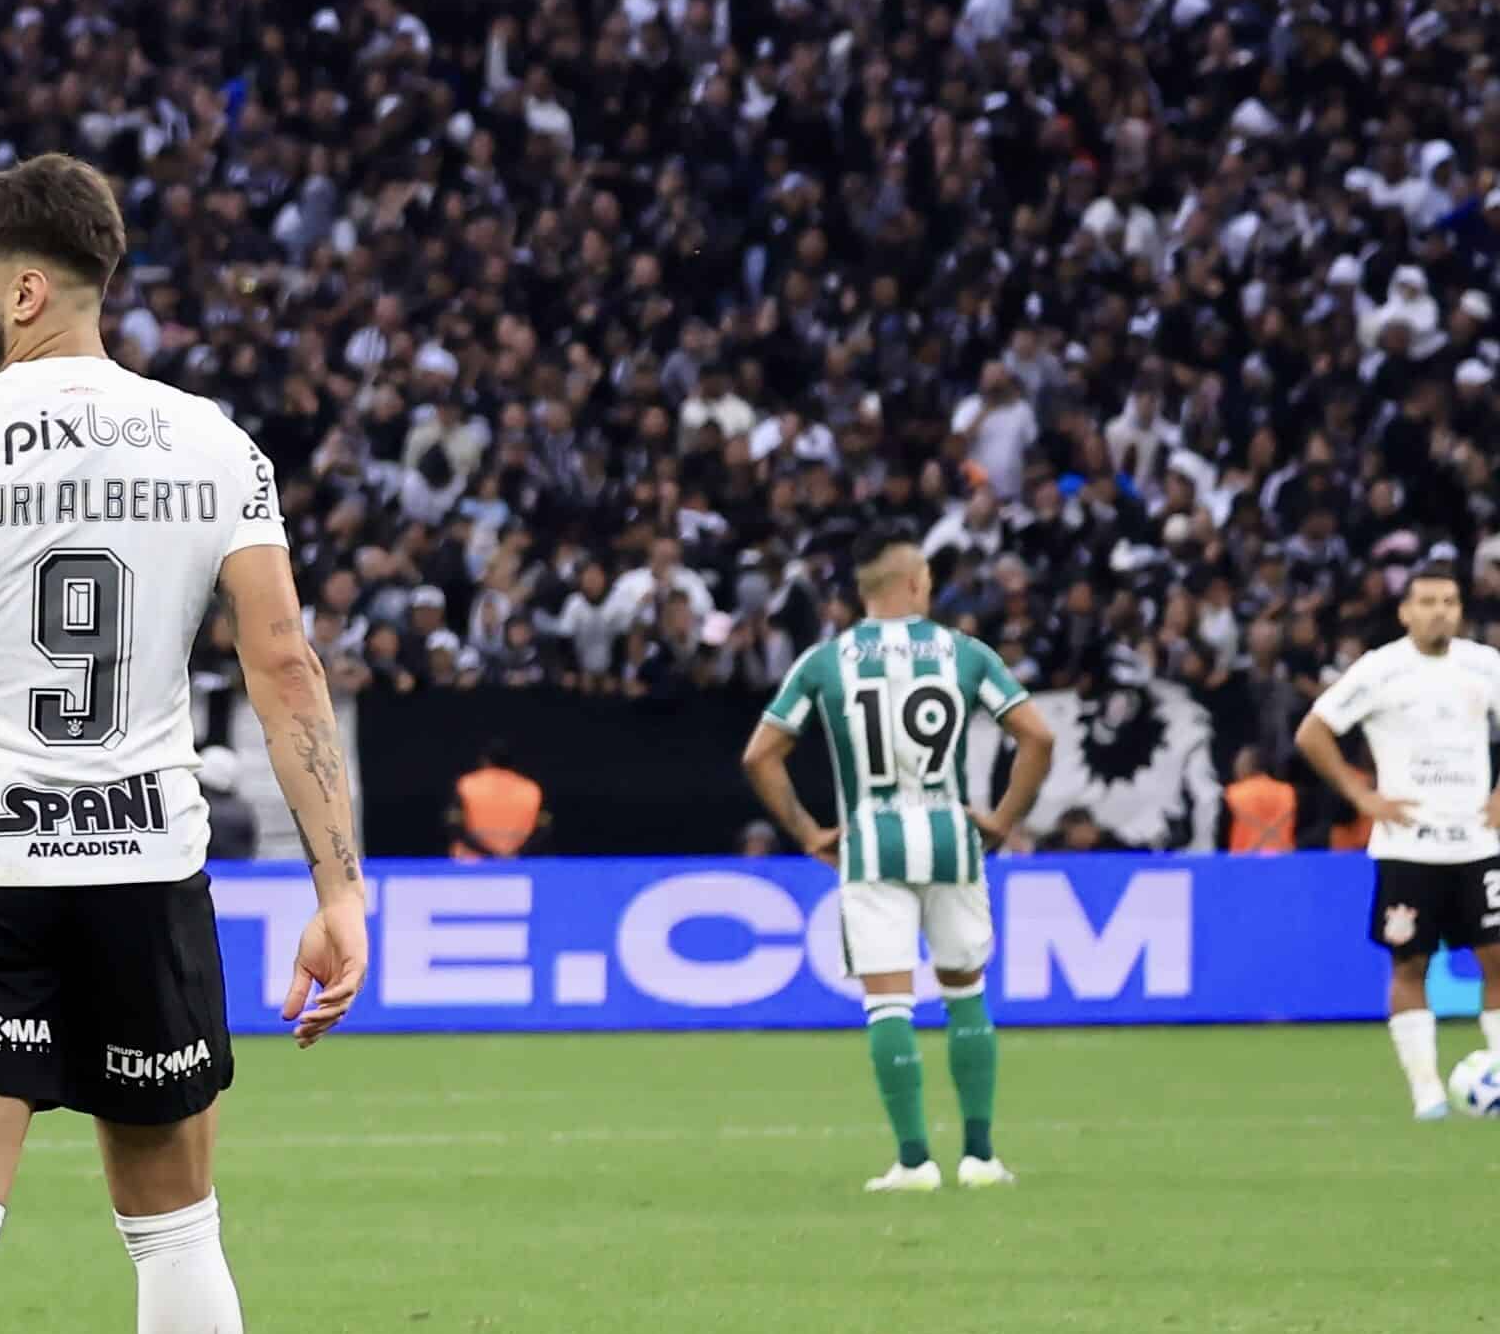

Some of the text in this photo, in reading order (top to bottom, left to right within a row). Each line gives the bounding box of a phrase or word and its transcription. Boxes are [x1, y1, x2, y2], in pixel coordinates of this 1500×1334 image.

[4, 404, 172, 466] pixbet
[54, 477, 218, 524] ALBERTO
[28, 547, 134, 750] 9
[853, 683, 960, 779] 19
[27, 839, 142, 858] ATACADISTA
[107, 1043, 144, 1057] GRUPO
